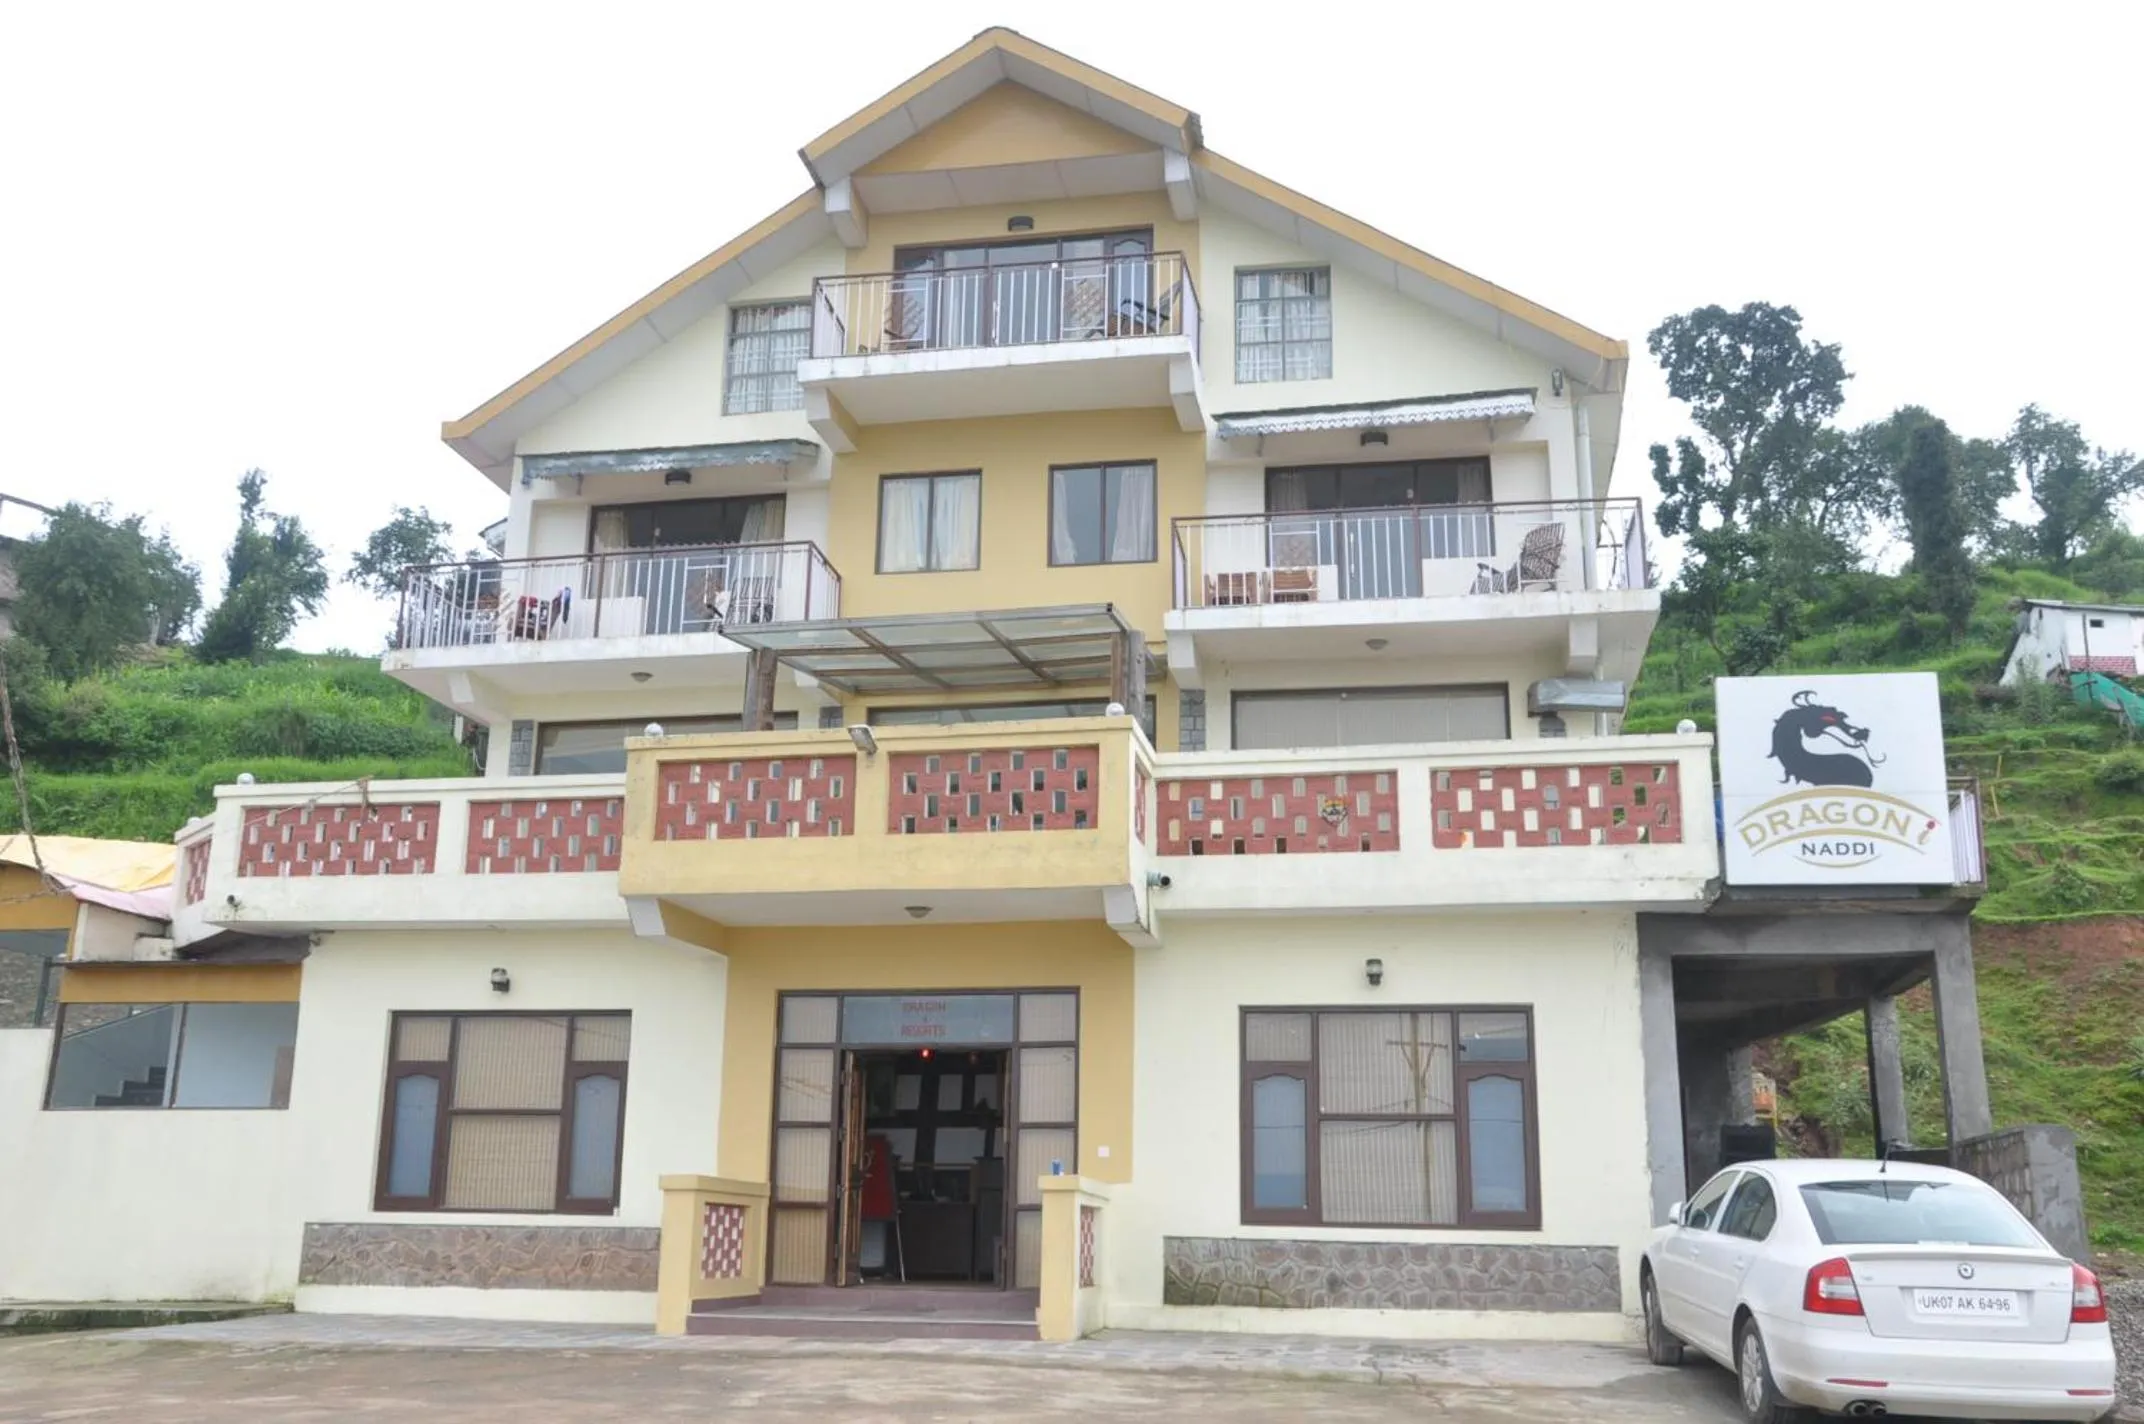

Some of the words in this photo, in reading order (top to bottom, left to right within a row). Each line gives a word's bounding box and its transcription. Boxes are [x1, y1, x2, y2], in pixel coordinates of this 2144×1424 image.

[1739, 801, 1911, 848] DRAGON
[1801, 842, 1876, 857] NADDI
[1958, 1297, 1975, 1309] AK
